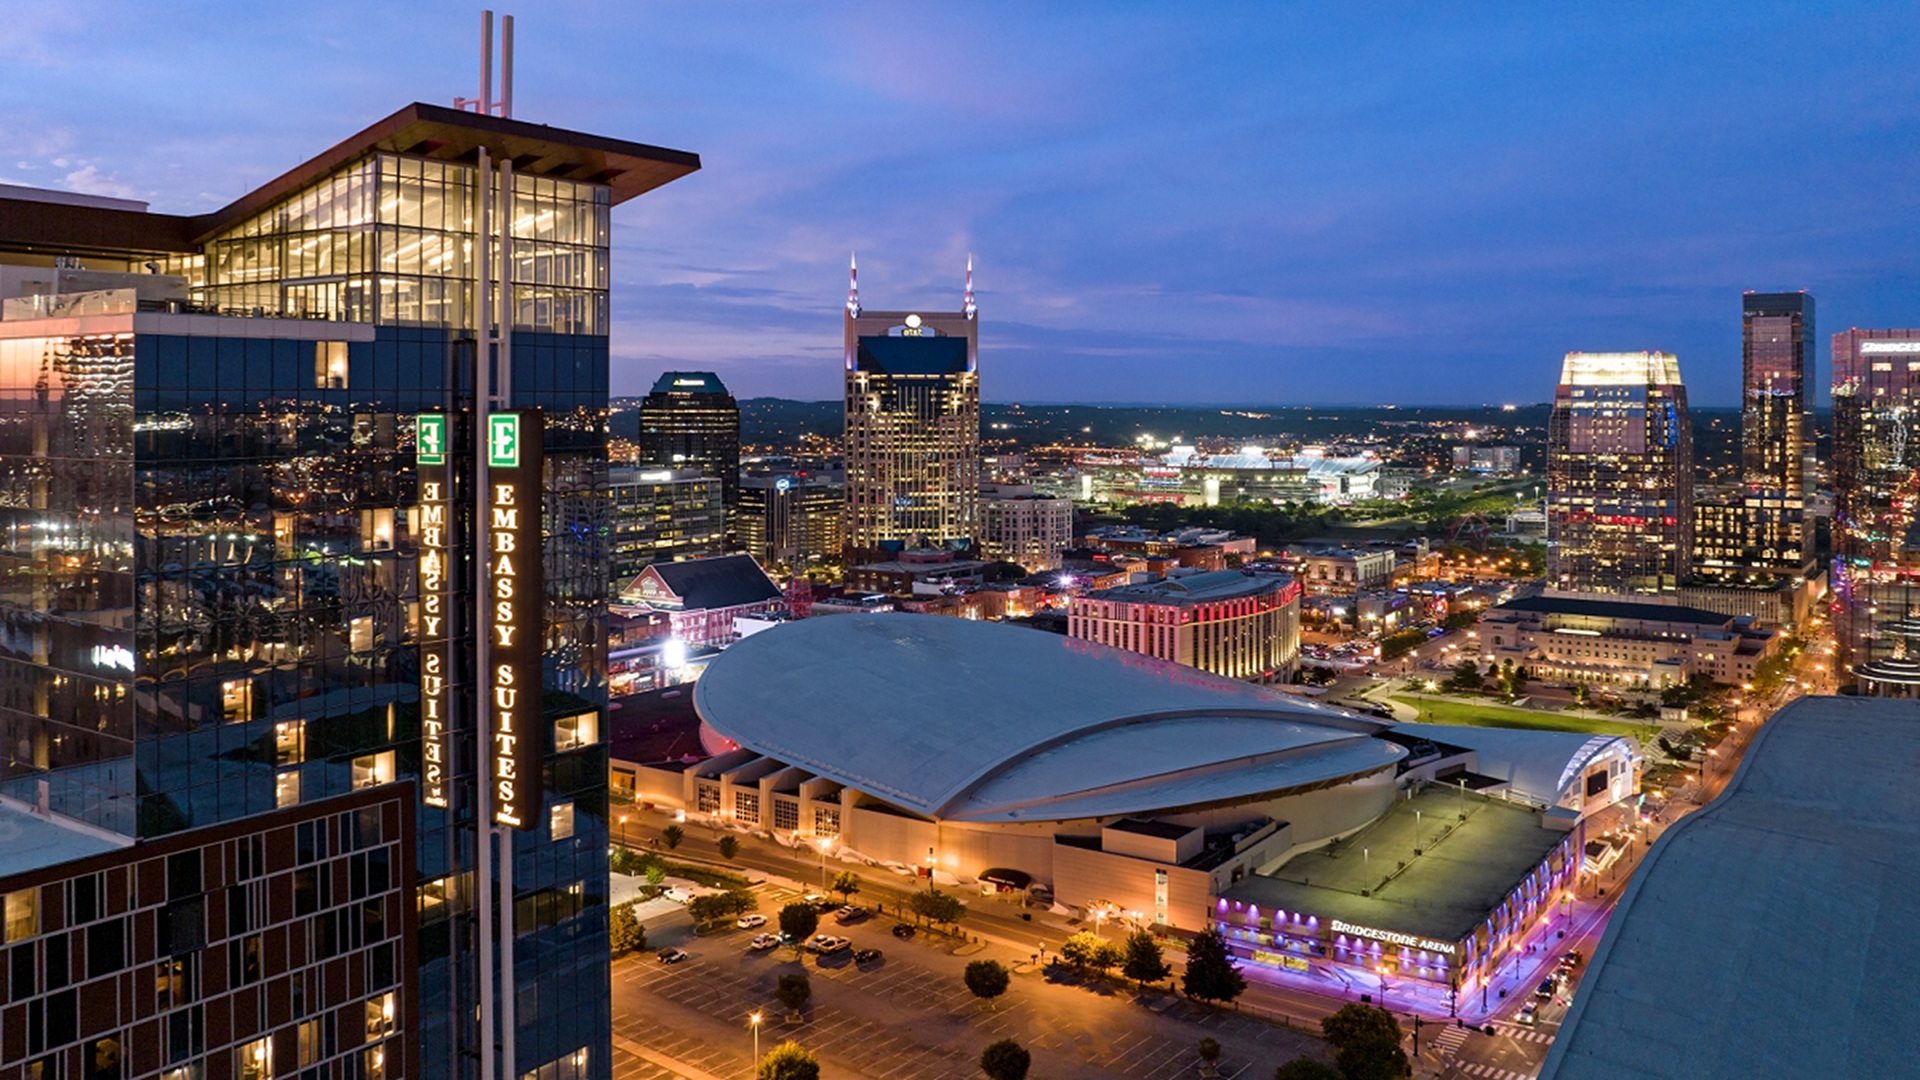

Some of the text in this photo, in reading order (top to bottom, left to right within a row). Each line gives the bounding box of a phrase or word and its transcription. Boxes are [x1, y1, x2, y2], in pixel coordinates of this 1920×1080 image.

[493, 422, 514, 459] E
[493, 485, 518, 647] EMBASSY
[495, 664, 517, 801] SUITES
[1331, 920, 1456, 954] BRIDGESTONE ARENA
